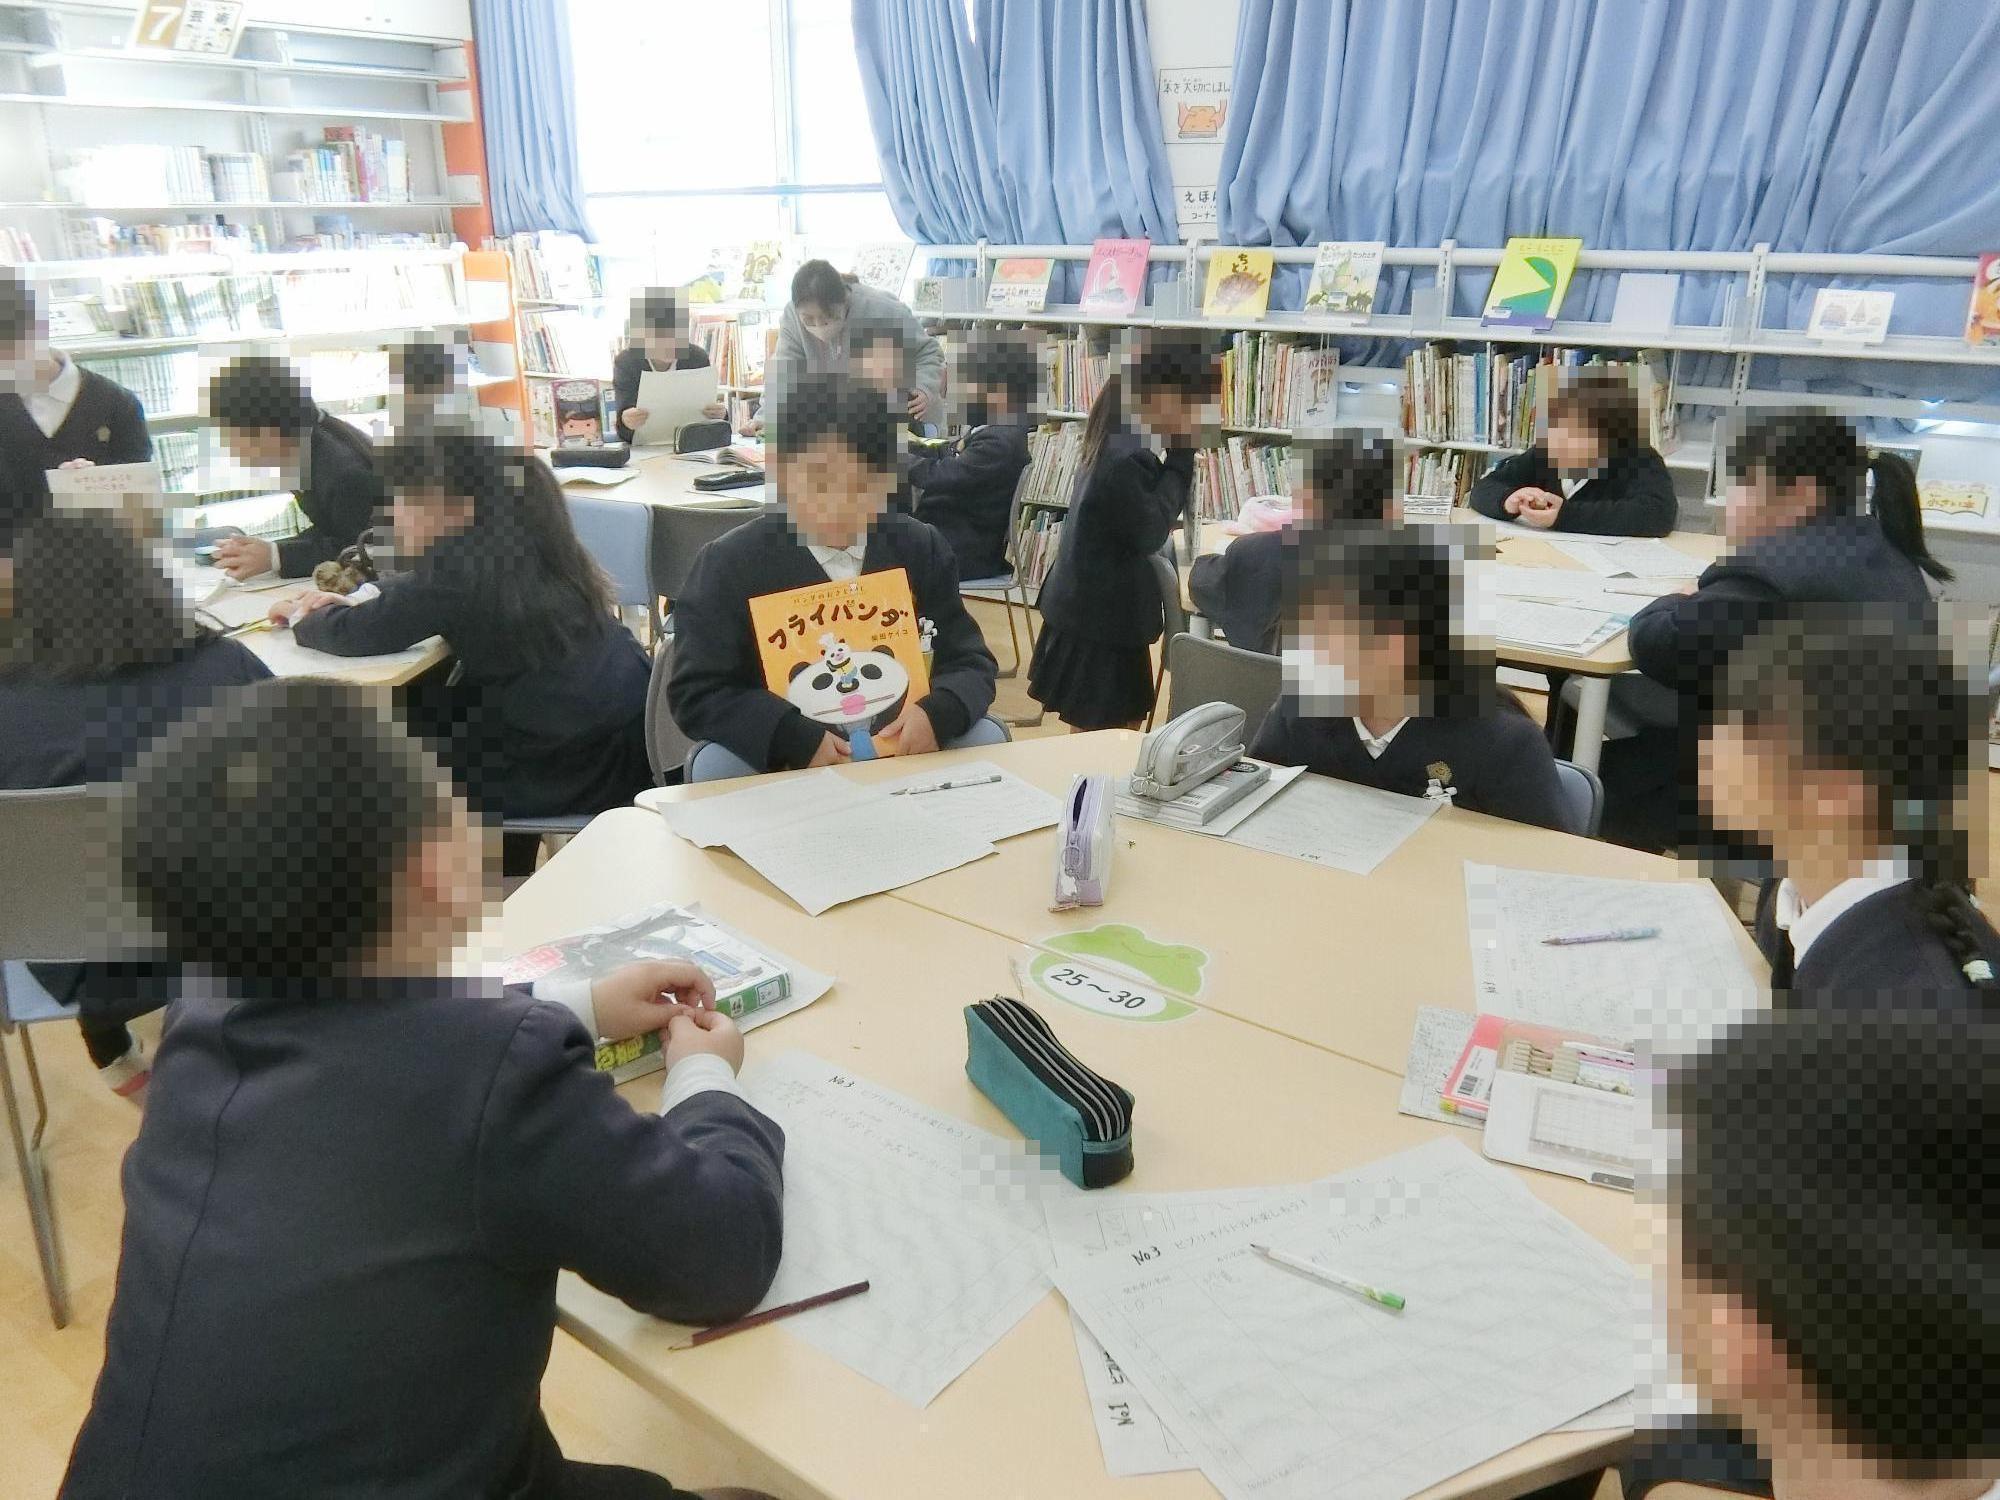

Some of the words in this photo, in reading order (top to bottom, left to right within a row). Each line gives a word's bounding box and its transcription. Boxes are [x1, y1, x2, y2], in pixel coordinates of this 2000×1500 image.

[147, 5, 180, 41] 7
[768, 603, 909, 650] フライパンダ
